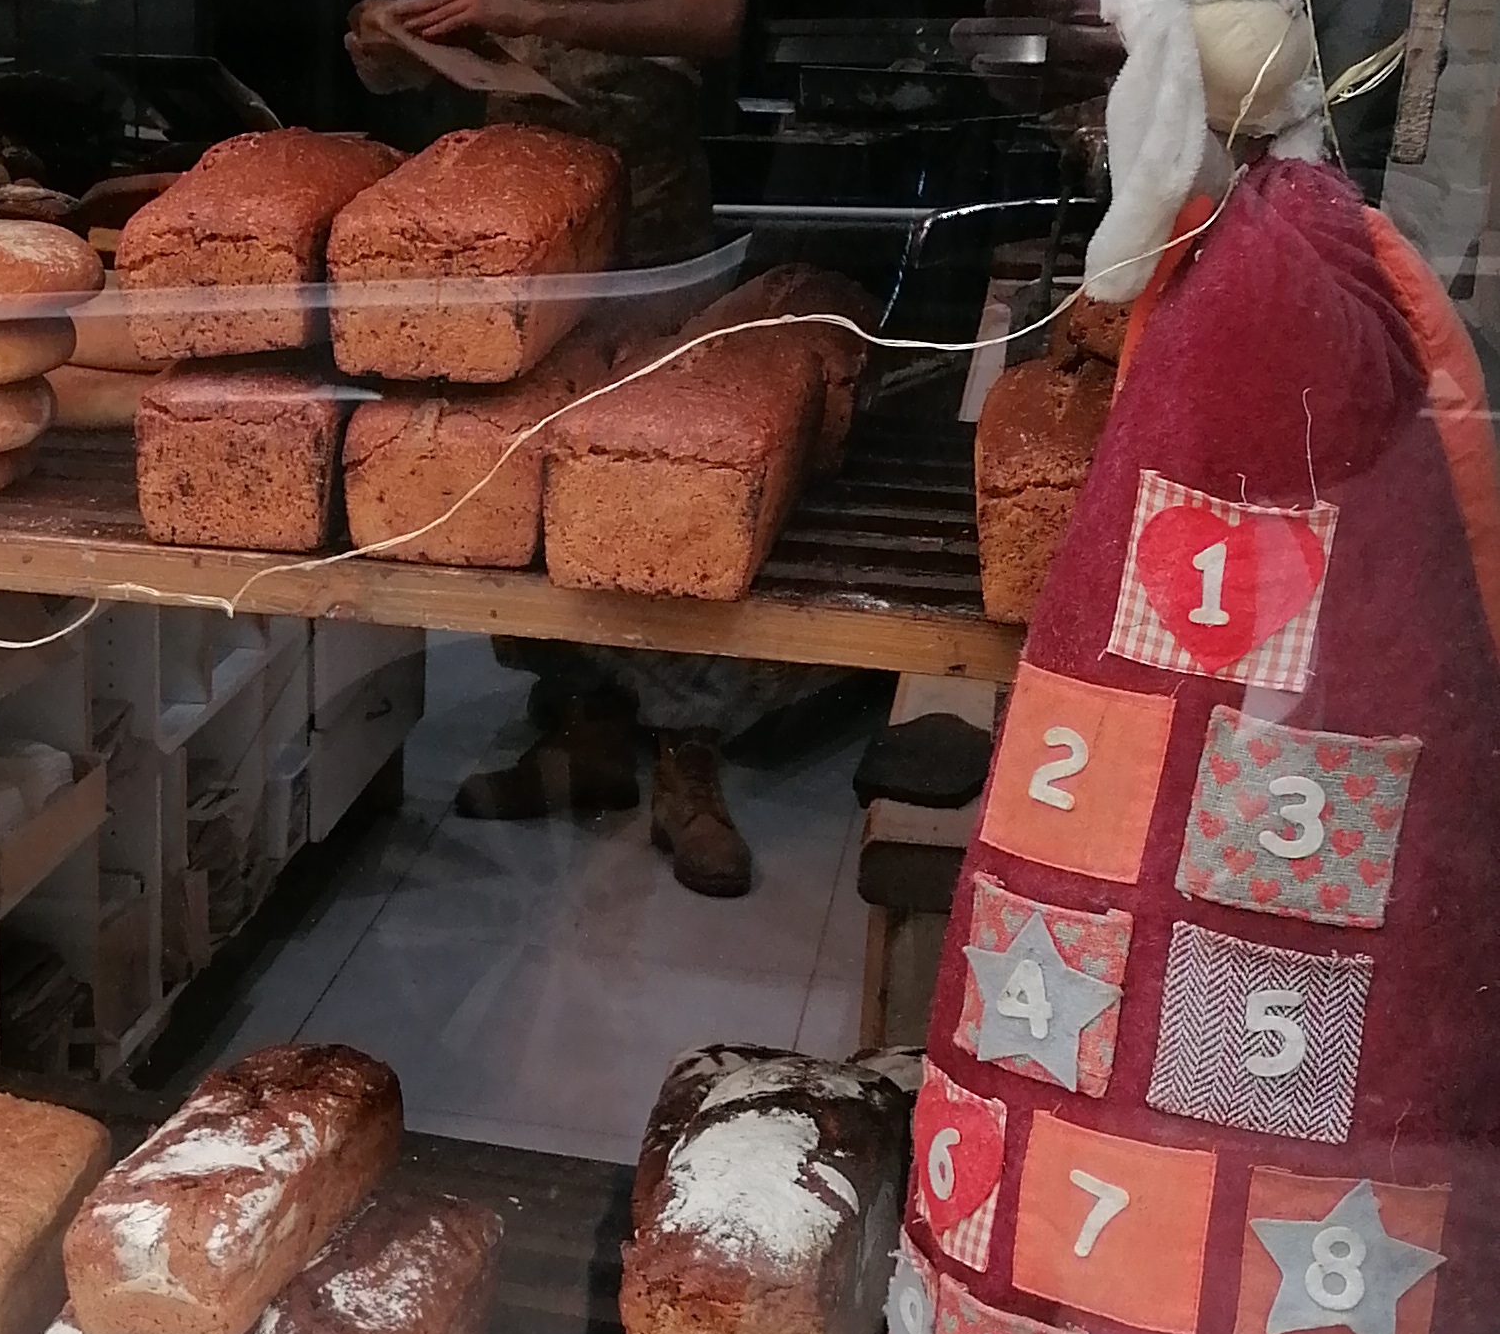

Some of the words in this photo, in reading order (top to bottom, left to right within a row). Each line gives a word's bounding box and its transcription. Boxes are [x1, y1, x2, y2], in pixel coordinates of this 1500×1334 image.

[1187, 543, 1229, 626] 1
[1028, 726, 1089, 811] 2
[1259, 775, 1326, 858] 3
[997, 959, 1053, 1039] 4
[1245, 989, 1306, 1077] 5
[928, 1127, 960, 1200] 6
[1069, 1169, 1130, 1257] 7
[1304, 1226, 1366, 1311] 8
